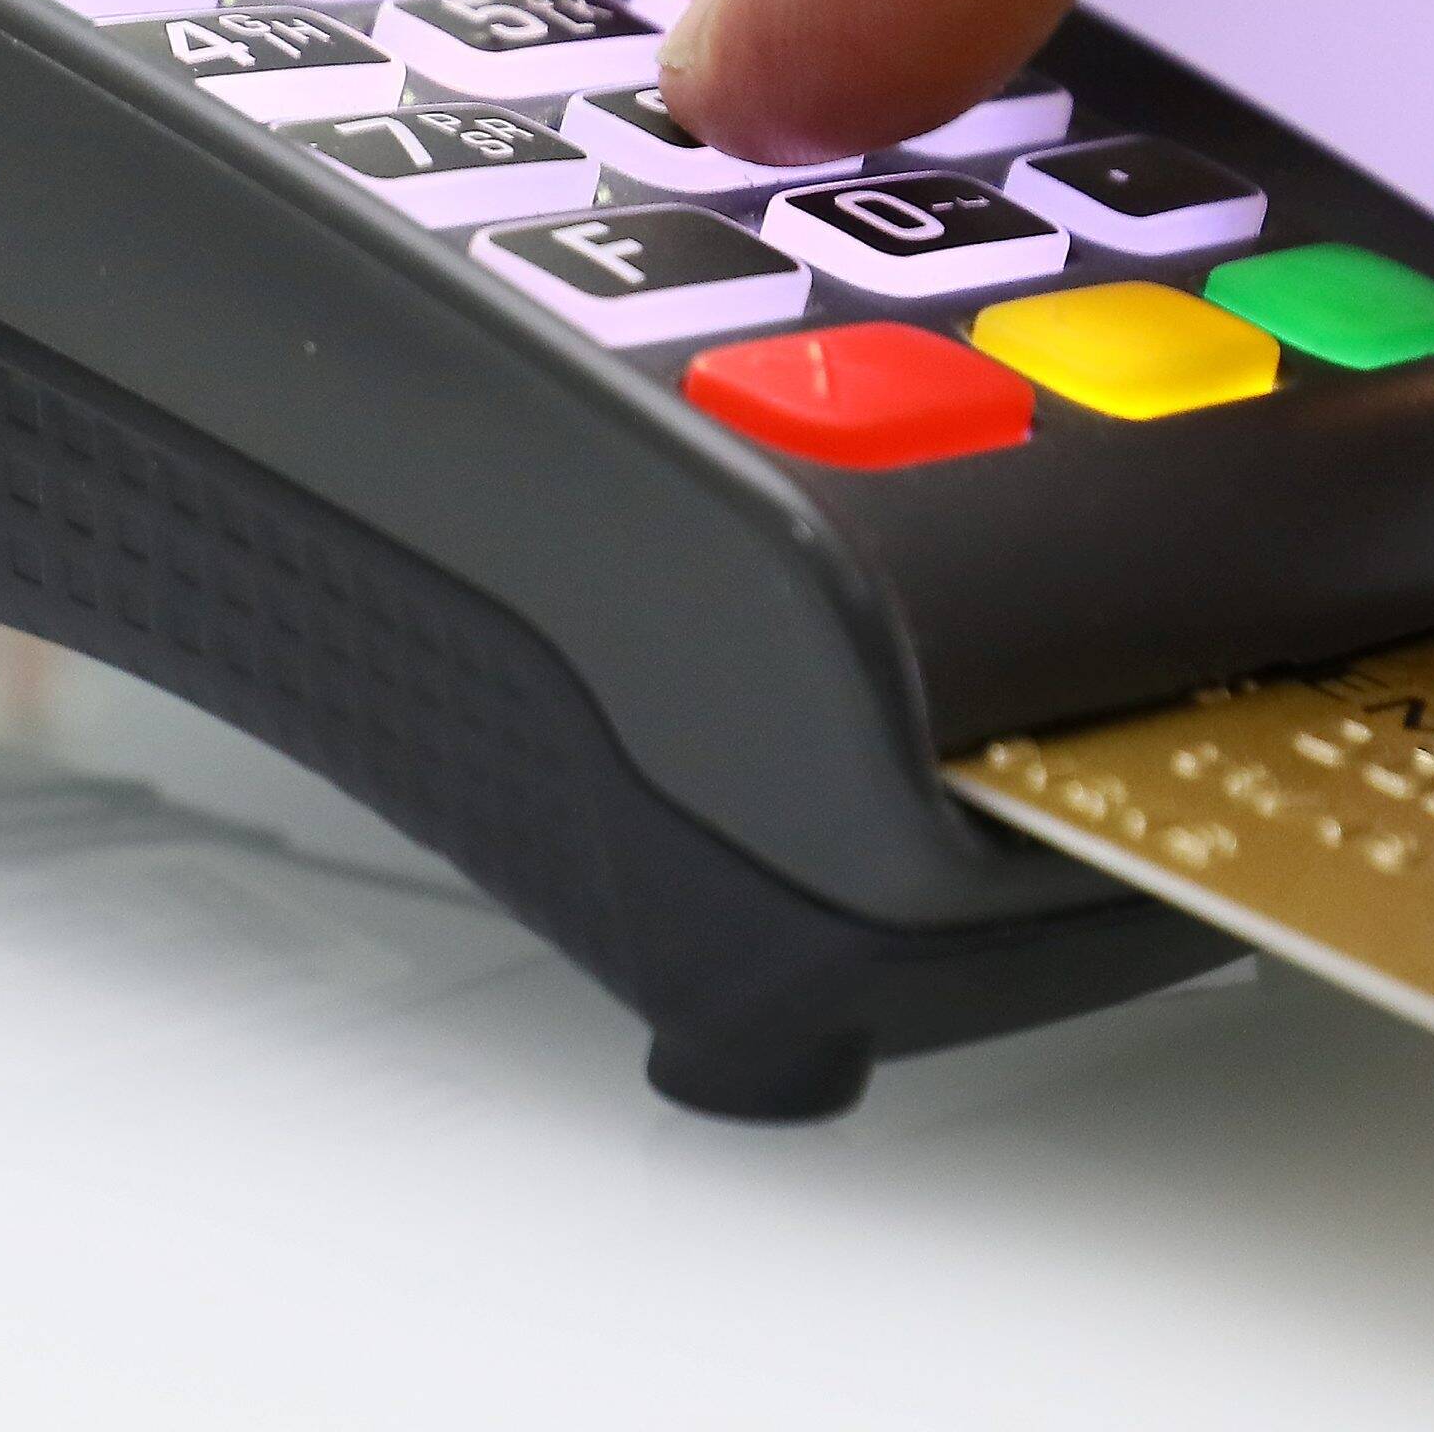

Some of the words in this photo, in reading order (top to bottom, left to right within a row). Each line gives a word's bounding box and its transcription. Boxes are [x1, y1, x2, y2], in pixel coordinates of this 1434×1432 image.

[165, 20, 256, 67] 4
[333, 116, 434, 168] 7
[549, 220, 647, 285] F
